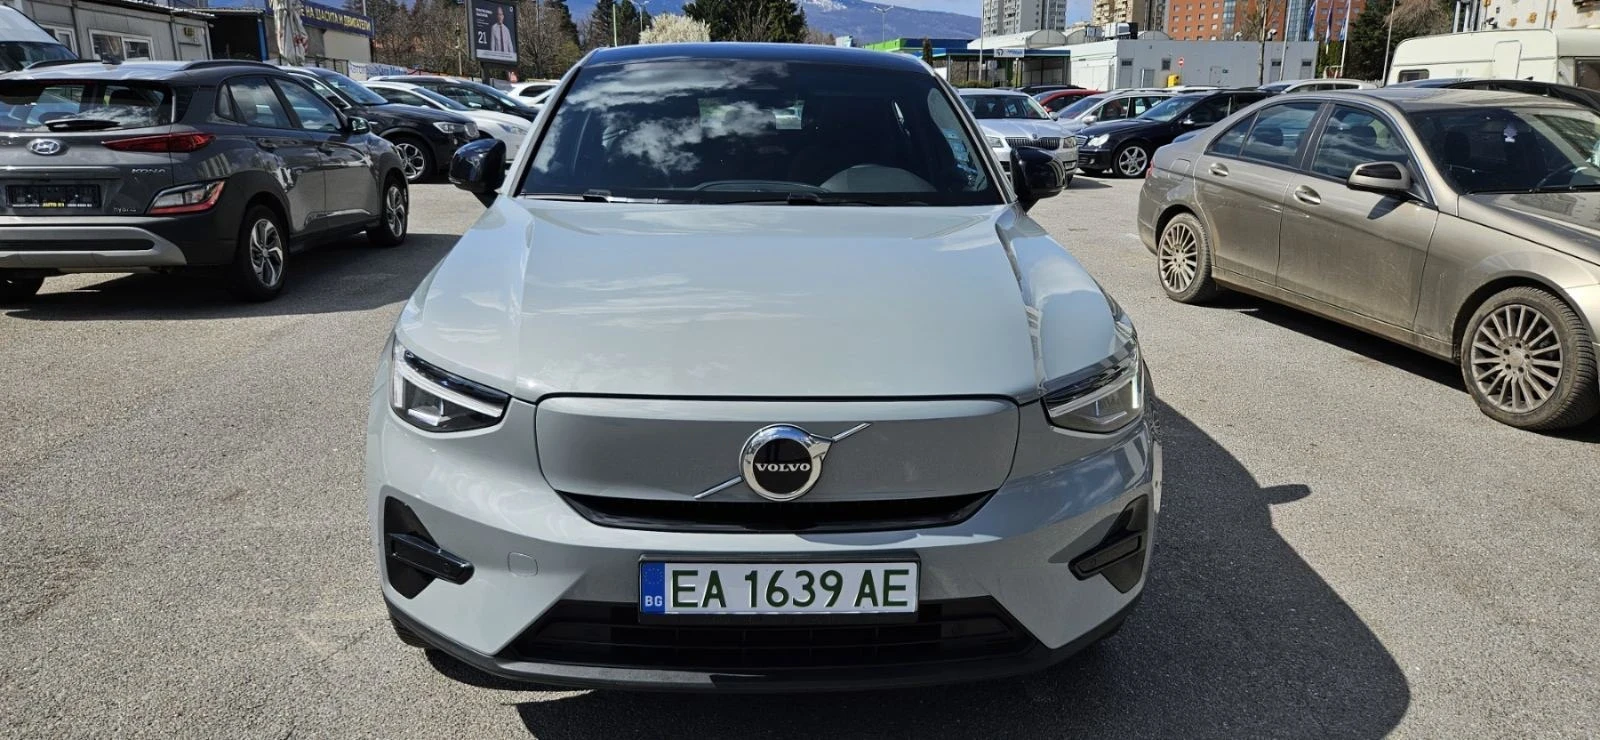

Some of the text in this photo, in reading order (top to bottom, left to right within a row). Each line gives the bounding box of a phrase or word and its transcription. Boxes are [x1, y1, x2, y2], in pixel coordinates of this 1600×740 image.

[478, 31, 487, 44] 21
[755, 463, 811, 472] VOLVO
[671, 569, 910, 608] EA 1639 AE
[644, 595, 663, 607] BG
